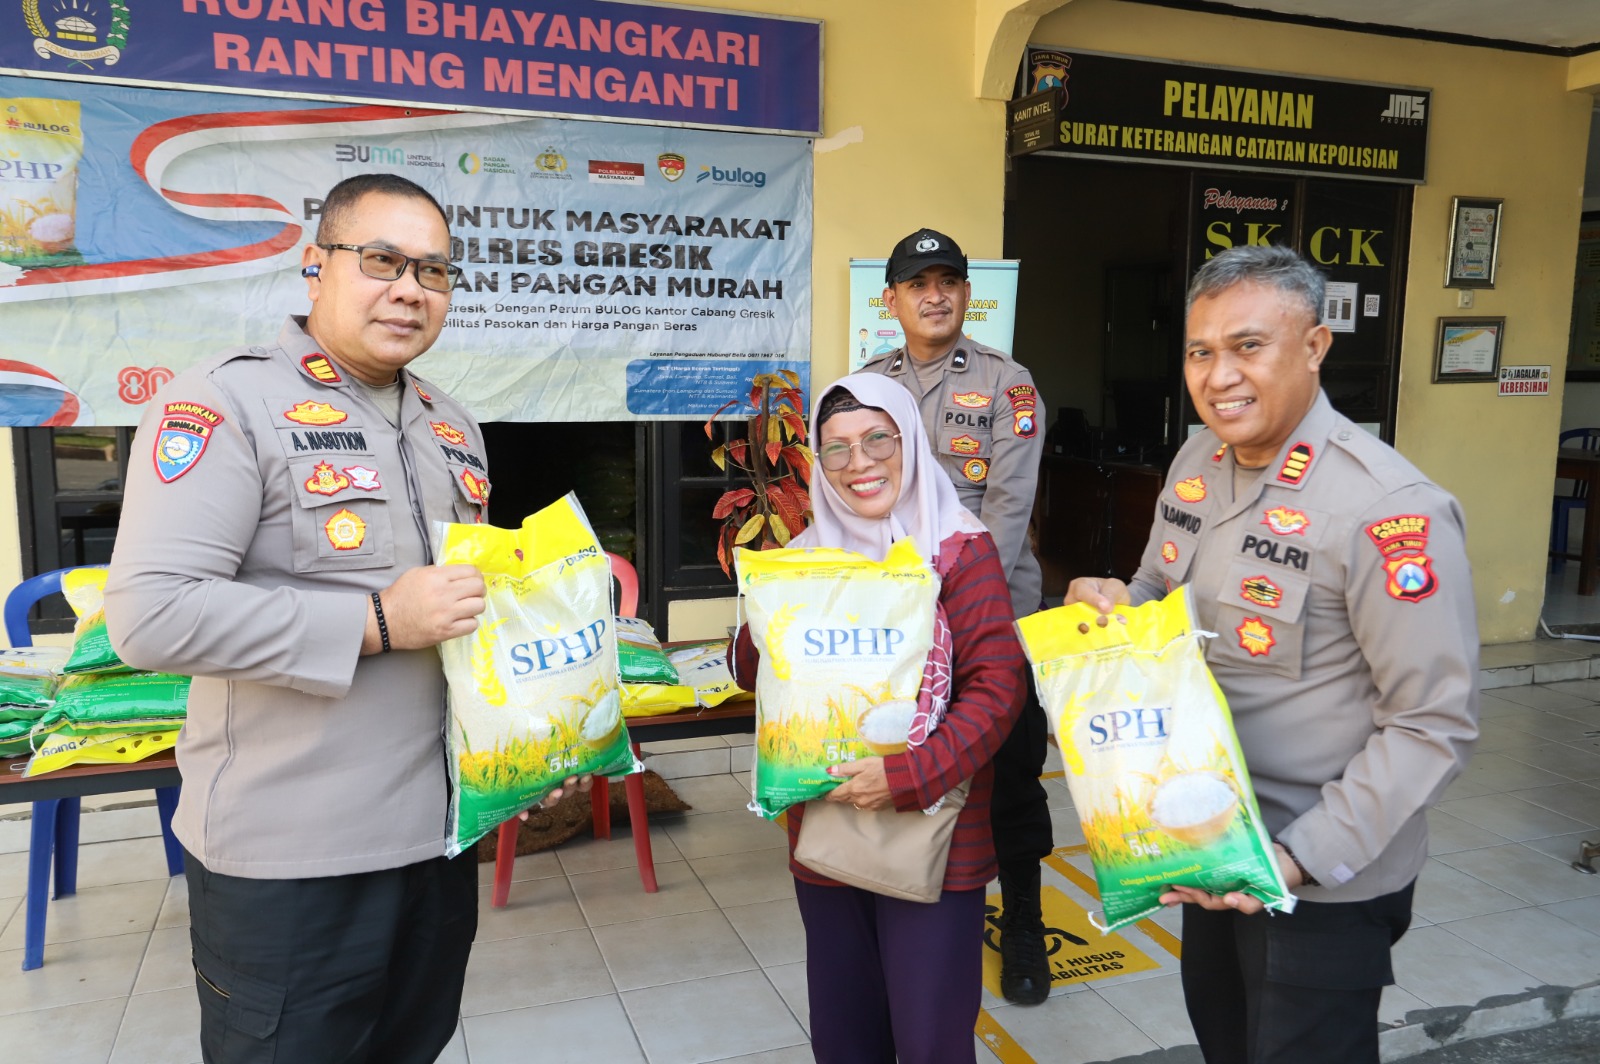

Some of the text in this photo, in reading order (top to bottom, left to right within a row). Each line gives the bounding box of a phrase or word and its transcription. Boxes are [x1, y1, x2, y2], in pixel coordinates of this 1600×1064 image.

[406, 0, 760, 67] BHAYANGKARI
[44, 41, 112, 59] KEMALA HIKMAH
[213, 32, 738, 111] RANTING MENGANTI
[1014, 101, 1051, 122] KANIT INTEL
[1163, 79, 1314, 129] PELAYANAN
[1380, 93, 1427, 119] JMS
[1380, 116, 1425, 126] PROJECT
[1060, 120, 1399, 170] SURAT KETERANGAN CATATAN KEPOLISIAN
[407, 160, 446, 168] INDONESIA
[712, 165, 767, 188] bulog
[1203, 187, 1278, 214] Pelayanan
[566, 210, 792, 241] MASYARAKAT
[573, 240, 713, 271] GRESIK
[511, 271, 656, 296] PANGAN
[667, 275, 783, 300] MURAH
[494, 303, 546, 315] Dengan
[549, 304, 591, 314] Perum
[595, 305, 641, 315] BULOG
[645, 306, 688, 316] Kantor
[691, 307, 736, 318] Cabang
[739, 308, 776, 319] Gresik
[484, 319, 539, 329] Pasokan
[543, 319, 568, 329] dan
[571, 320, 610, 331] Harga
[613, 321, 660, 332] Pangan
[663, 321, 698, 331] Beras
[1513, 369, 1541, 379] JAGALAH
[1500, 381, 1549, 393] KEBERSIHAN
[168, 403, 218, 423] BAHARKAM
[945, 411, 993, 428] POLRI
[167, 420, 204, 434] BINMAS
[290, 431, 367, 451] A. NASUTION
[1371, 517, 1425, 536] POLRES
[1241, 534, 1309, 571] POLRI
[510, 618, 606, 677] SPHP
[804, 627, 905, 657] SPHP
[1089, 707, 1172, 746] SPH
[826, 745, 856, 762] 5 kg
[549, 756, 562, 773] 5
[1128, 838, 1143, 858] 5
